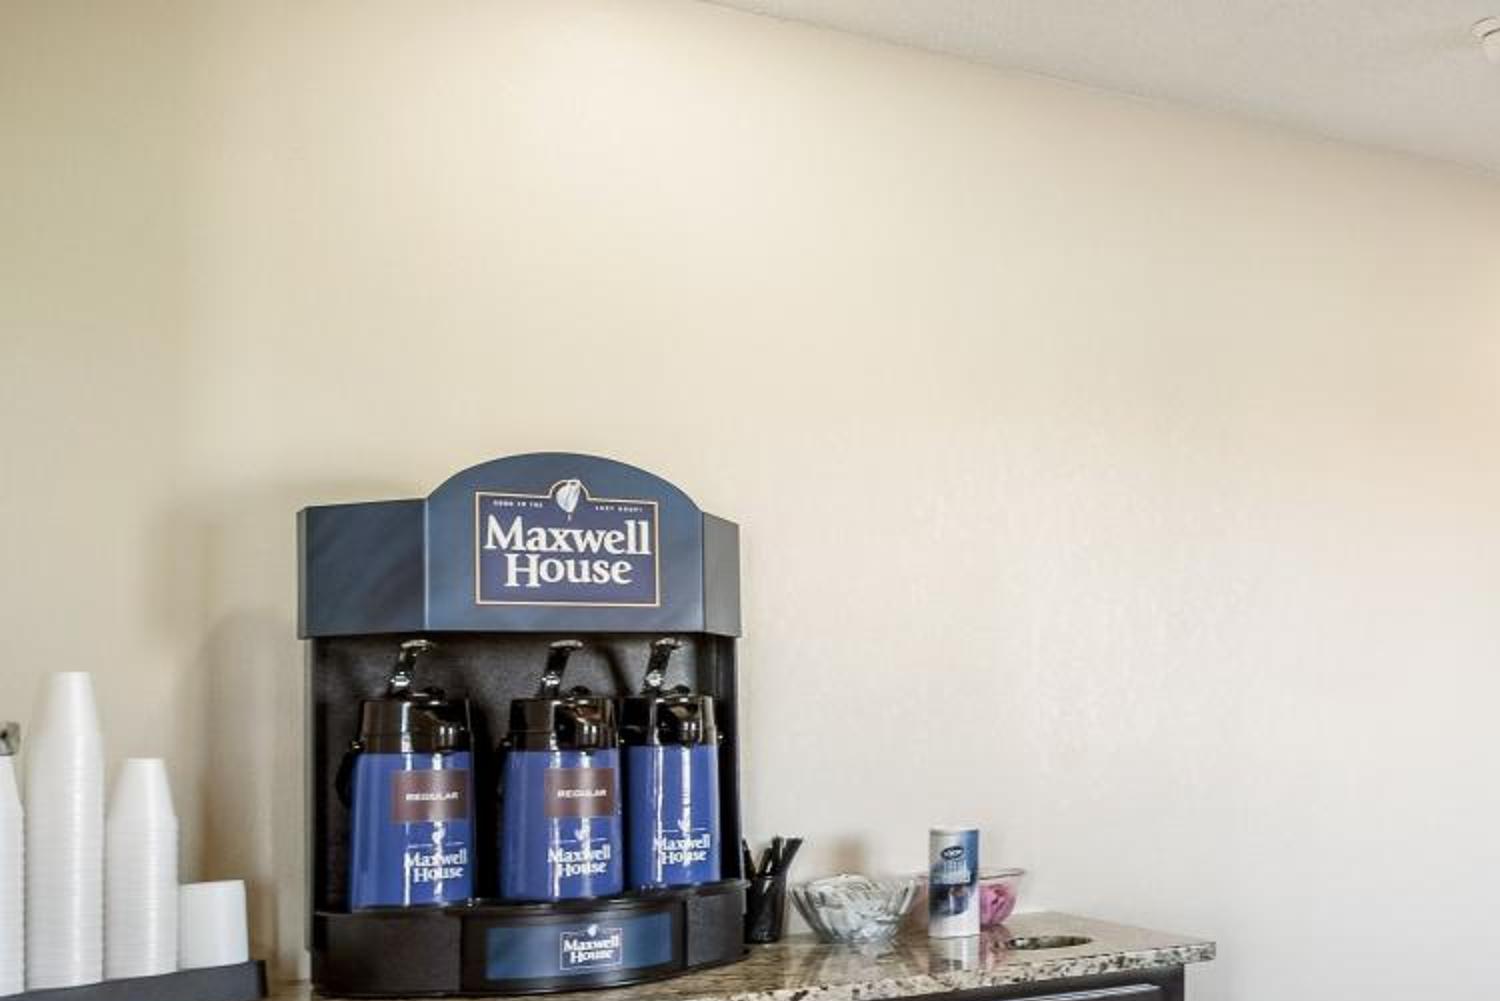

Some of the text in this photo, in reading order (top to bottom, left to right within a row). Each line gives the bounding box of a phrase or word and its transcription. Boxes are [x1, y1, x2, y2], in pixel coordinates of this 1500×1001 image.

[484, 514, 650, 555] Maxwell
[504, 554, 632, 587] House
[547, 844, 611, 863] Maxwell
[563, 935, 619, 952] Maxwell
[570, 949, 614, 964] House
